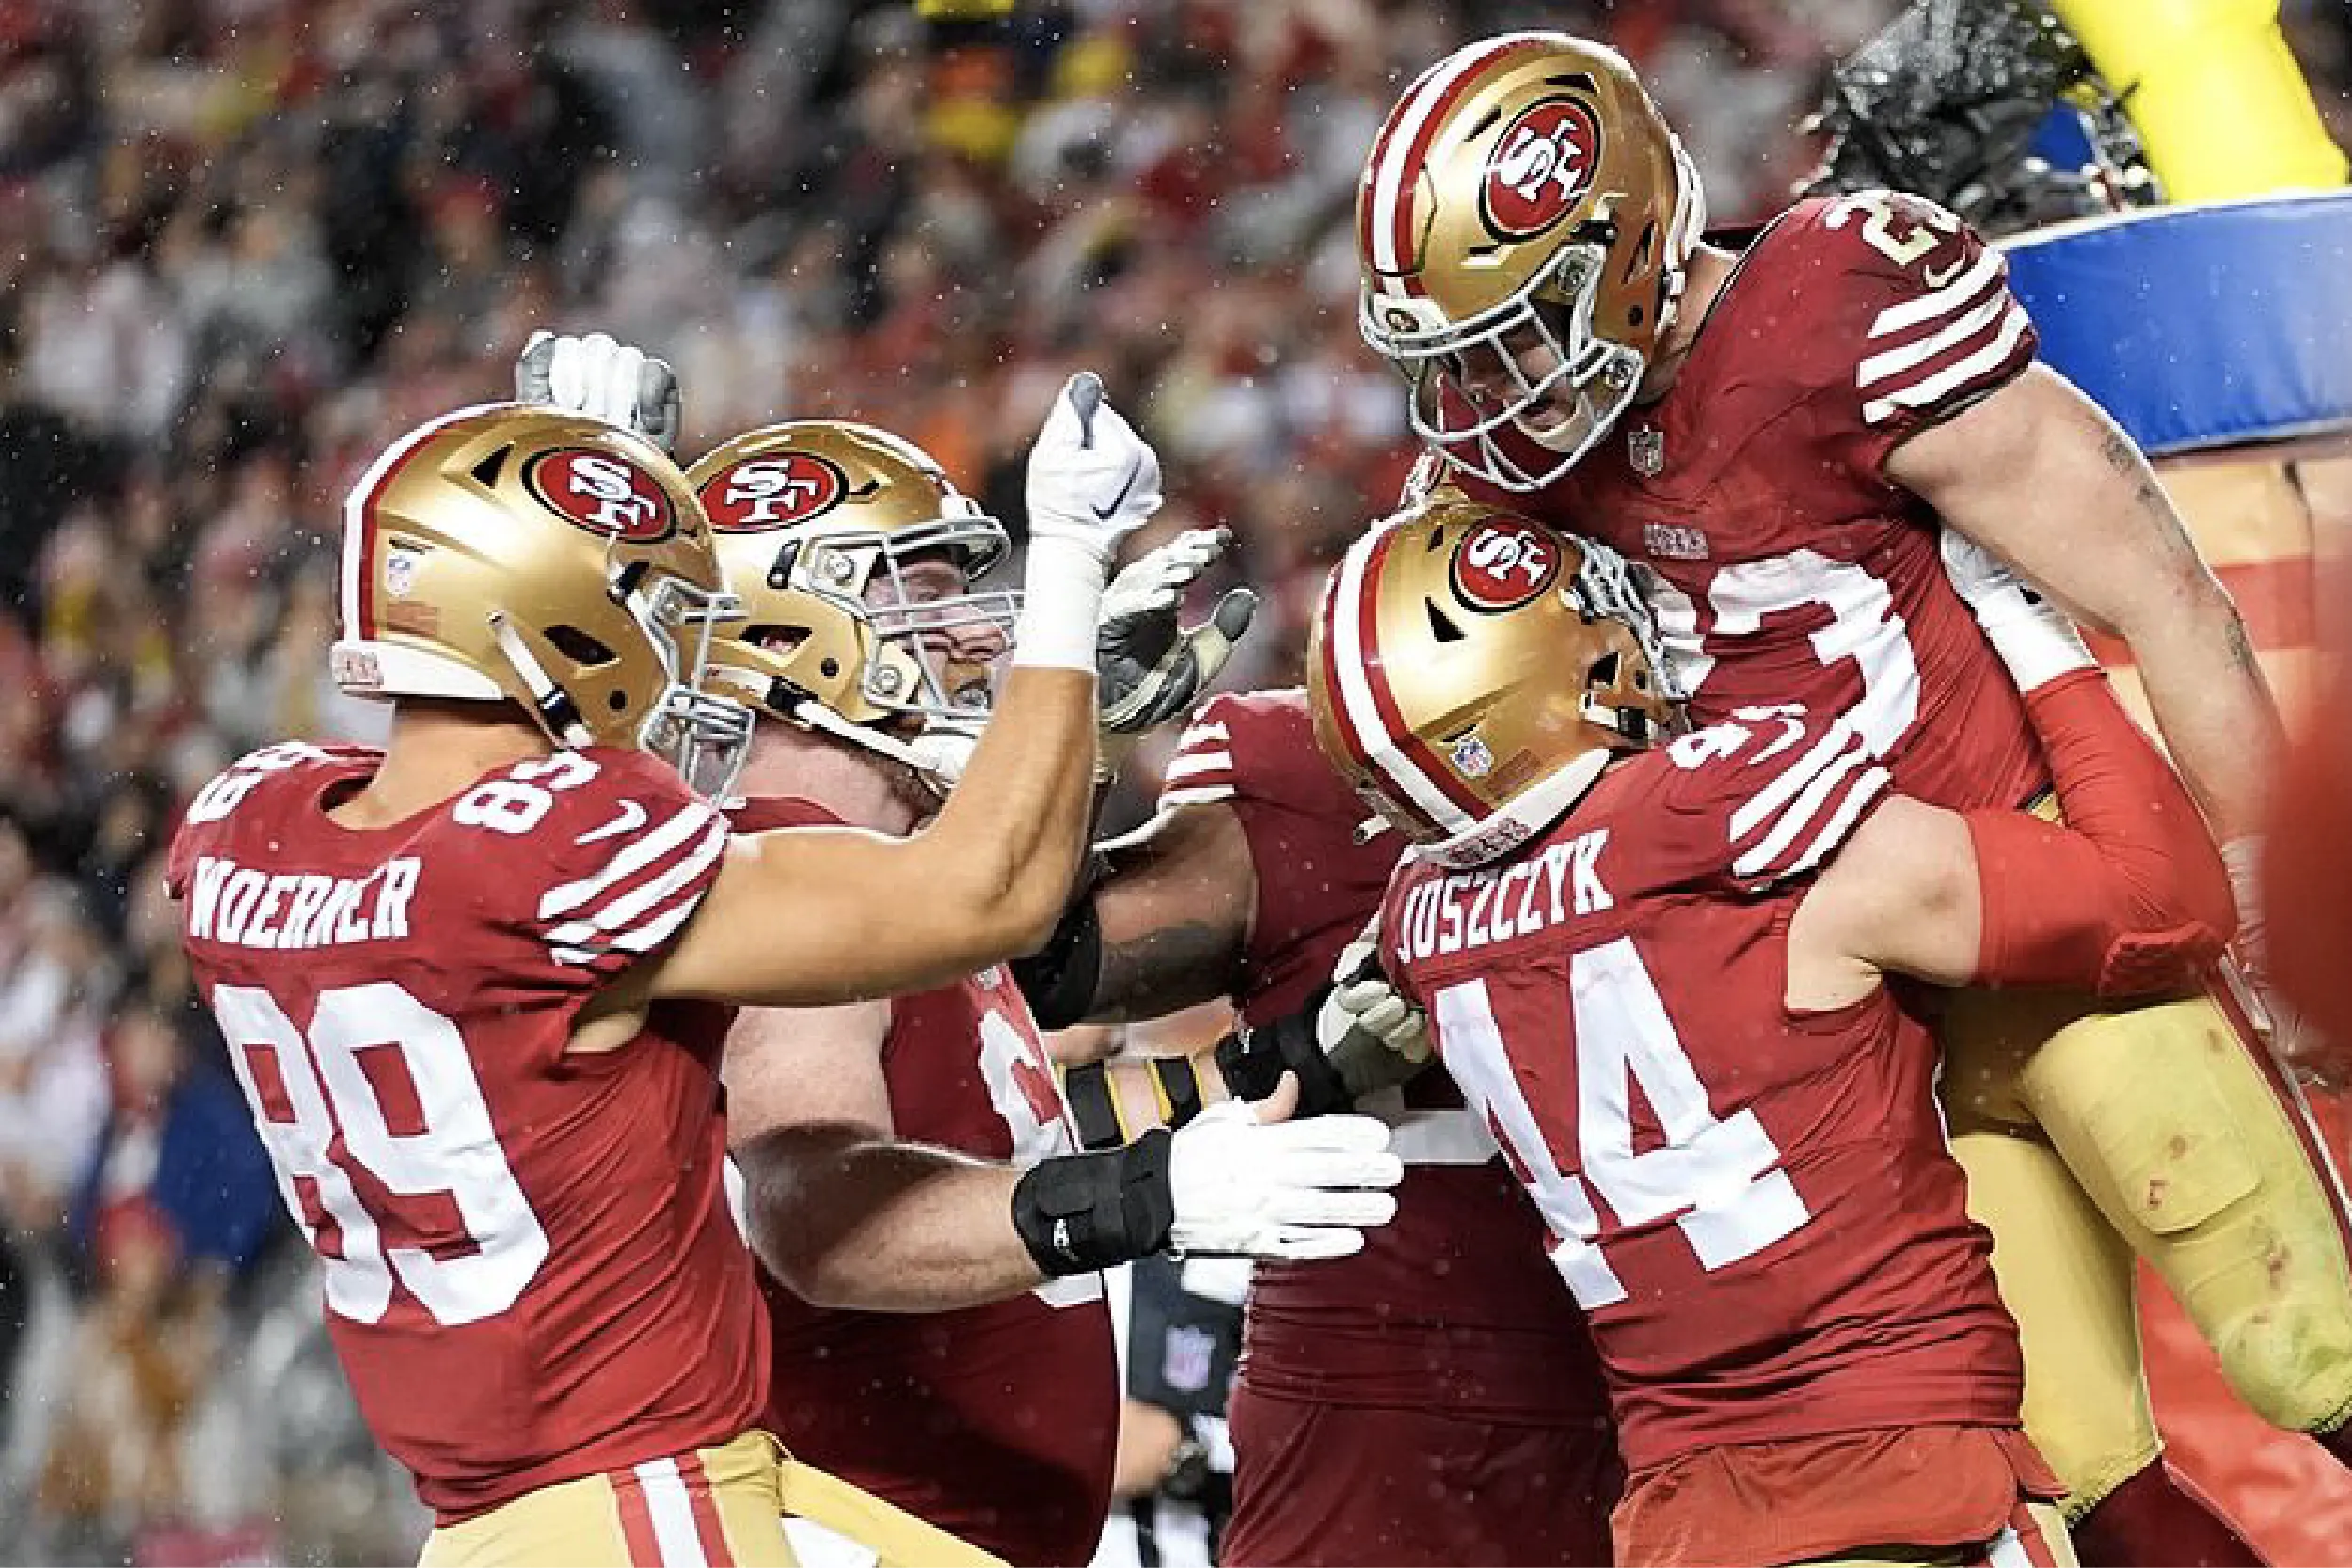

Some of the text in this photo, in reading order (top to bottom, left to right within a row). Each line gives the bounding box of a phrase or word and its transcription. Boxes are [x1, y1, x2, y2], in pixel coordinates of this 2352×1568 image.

[1481, 117, 1587, 209] SF
[568, 455, 657, 531] SF
[725, 460, 816, 525] SF
[1470, 526, 1552, 588] SF
[191, 856, 421, 948] WOERNER
[213, 980, 550, 1326] 89
[1434, 935, 1812, 1310] 44
